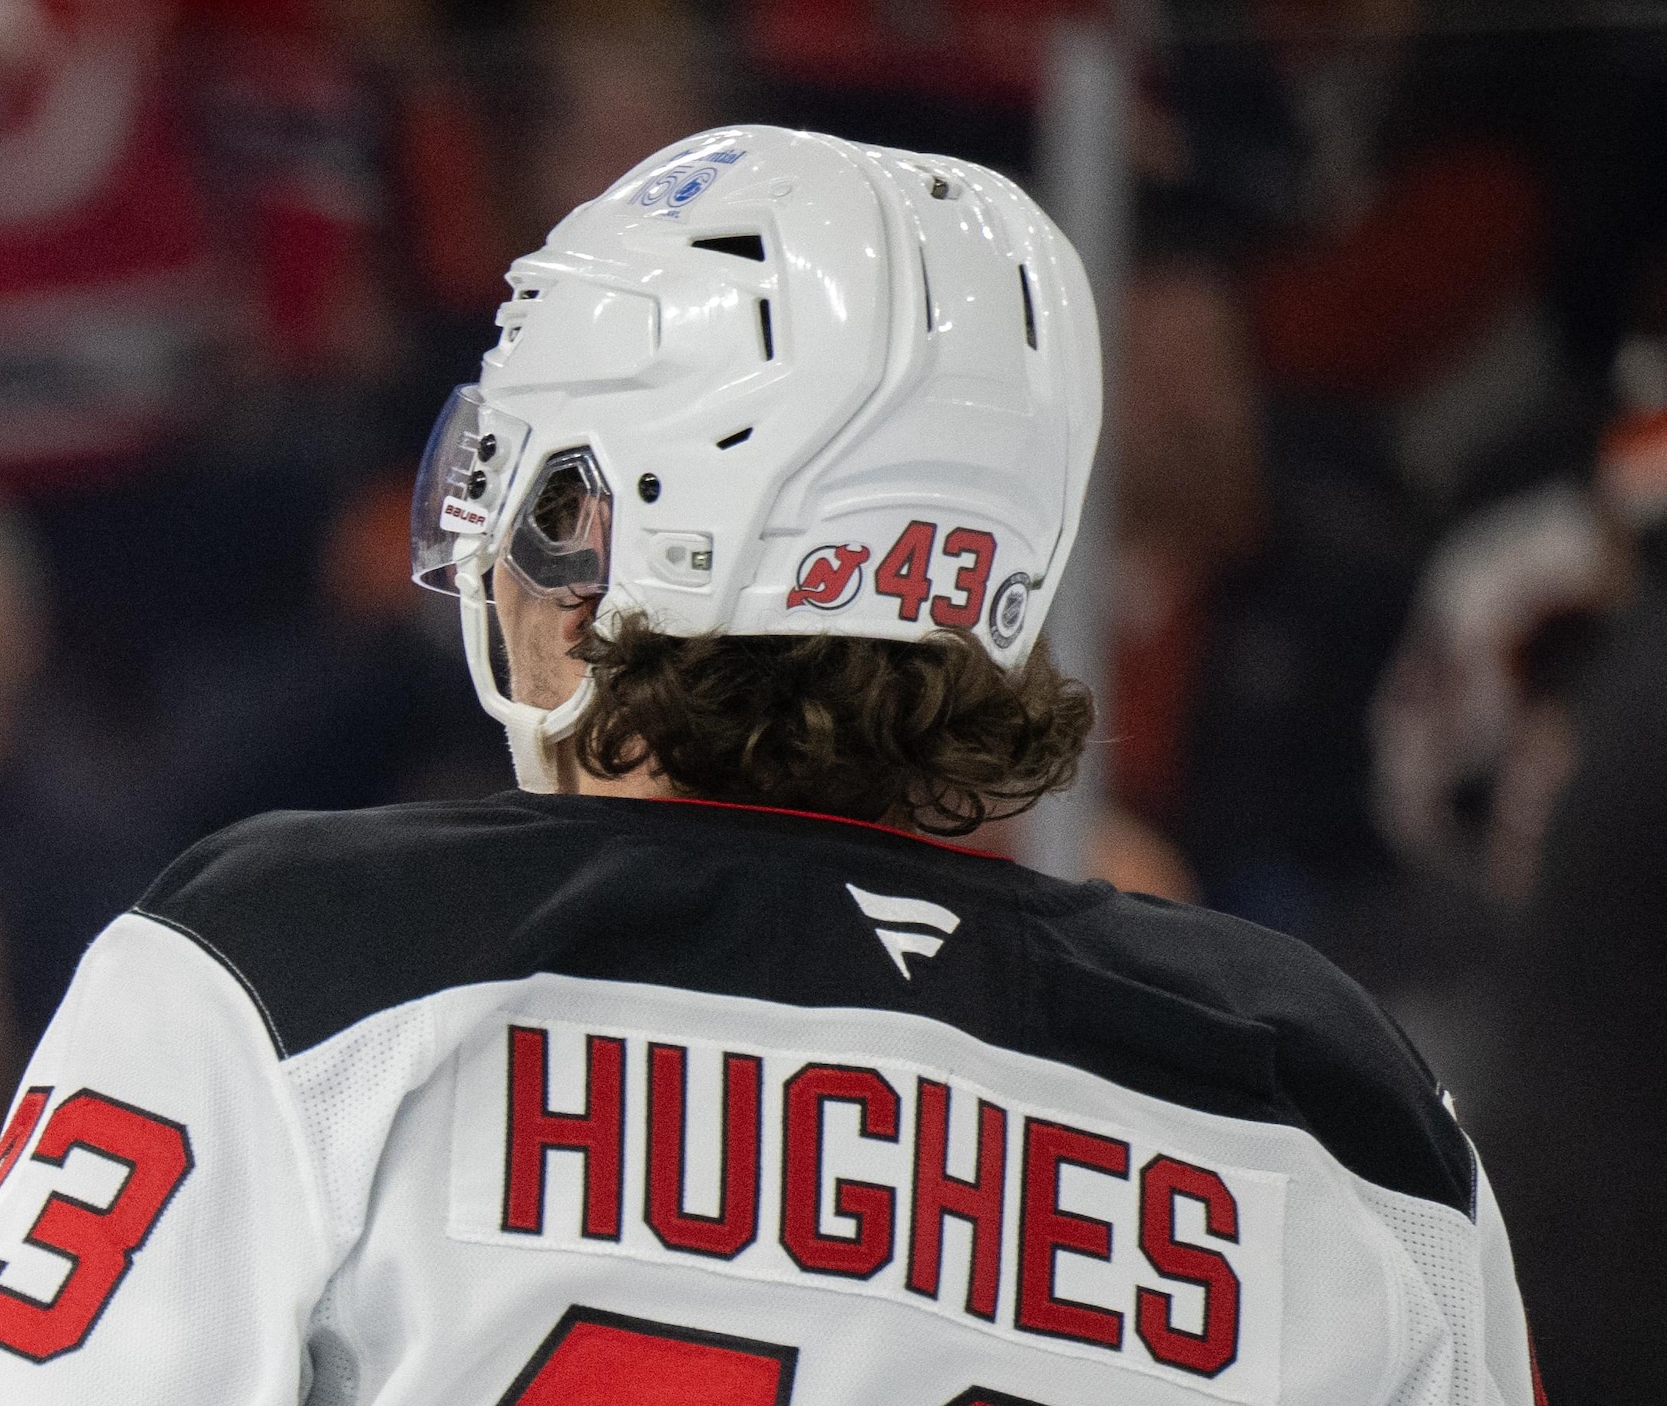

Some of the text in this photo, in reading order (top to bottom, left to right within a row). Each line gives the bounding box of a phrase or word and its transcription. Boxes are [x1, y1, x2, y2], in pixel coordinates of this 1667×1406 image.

[444, 504, 487, 525] BAUER
[874, 520, 998, 628] 43
[501, 1023, 1241, 1380] HUGHES
